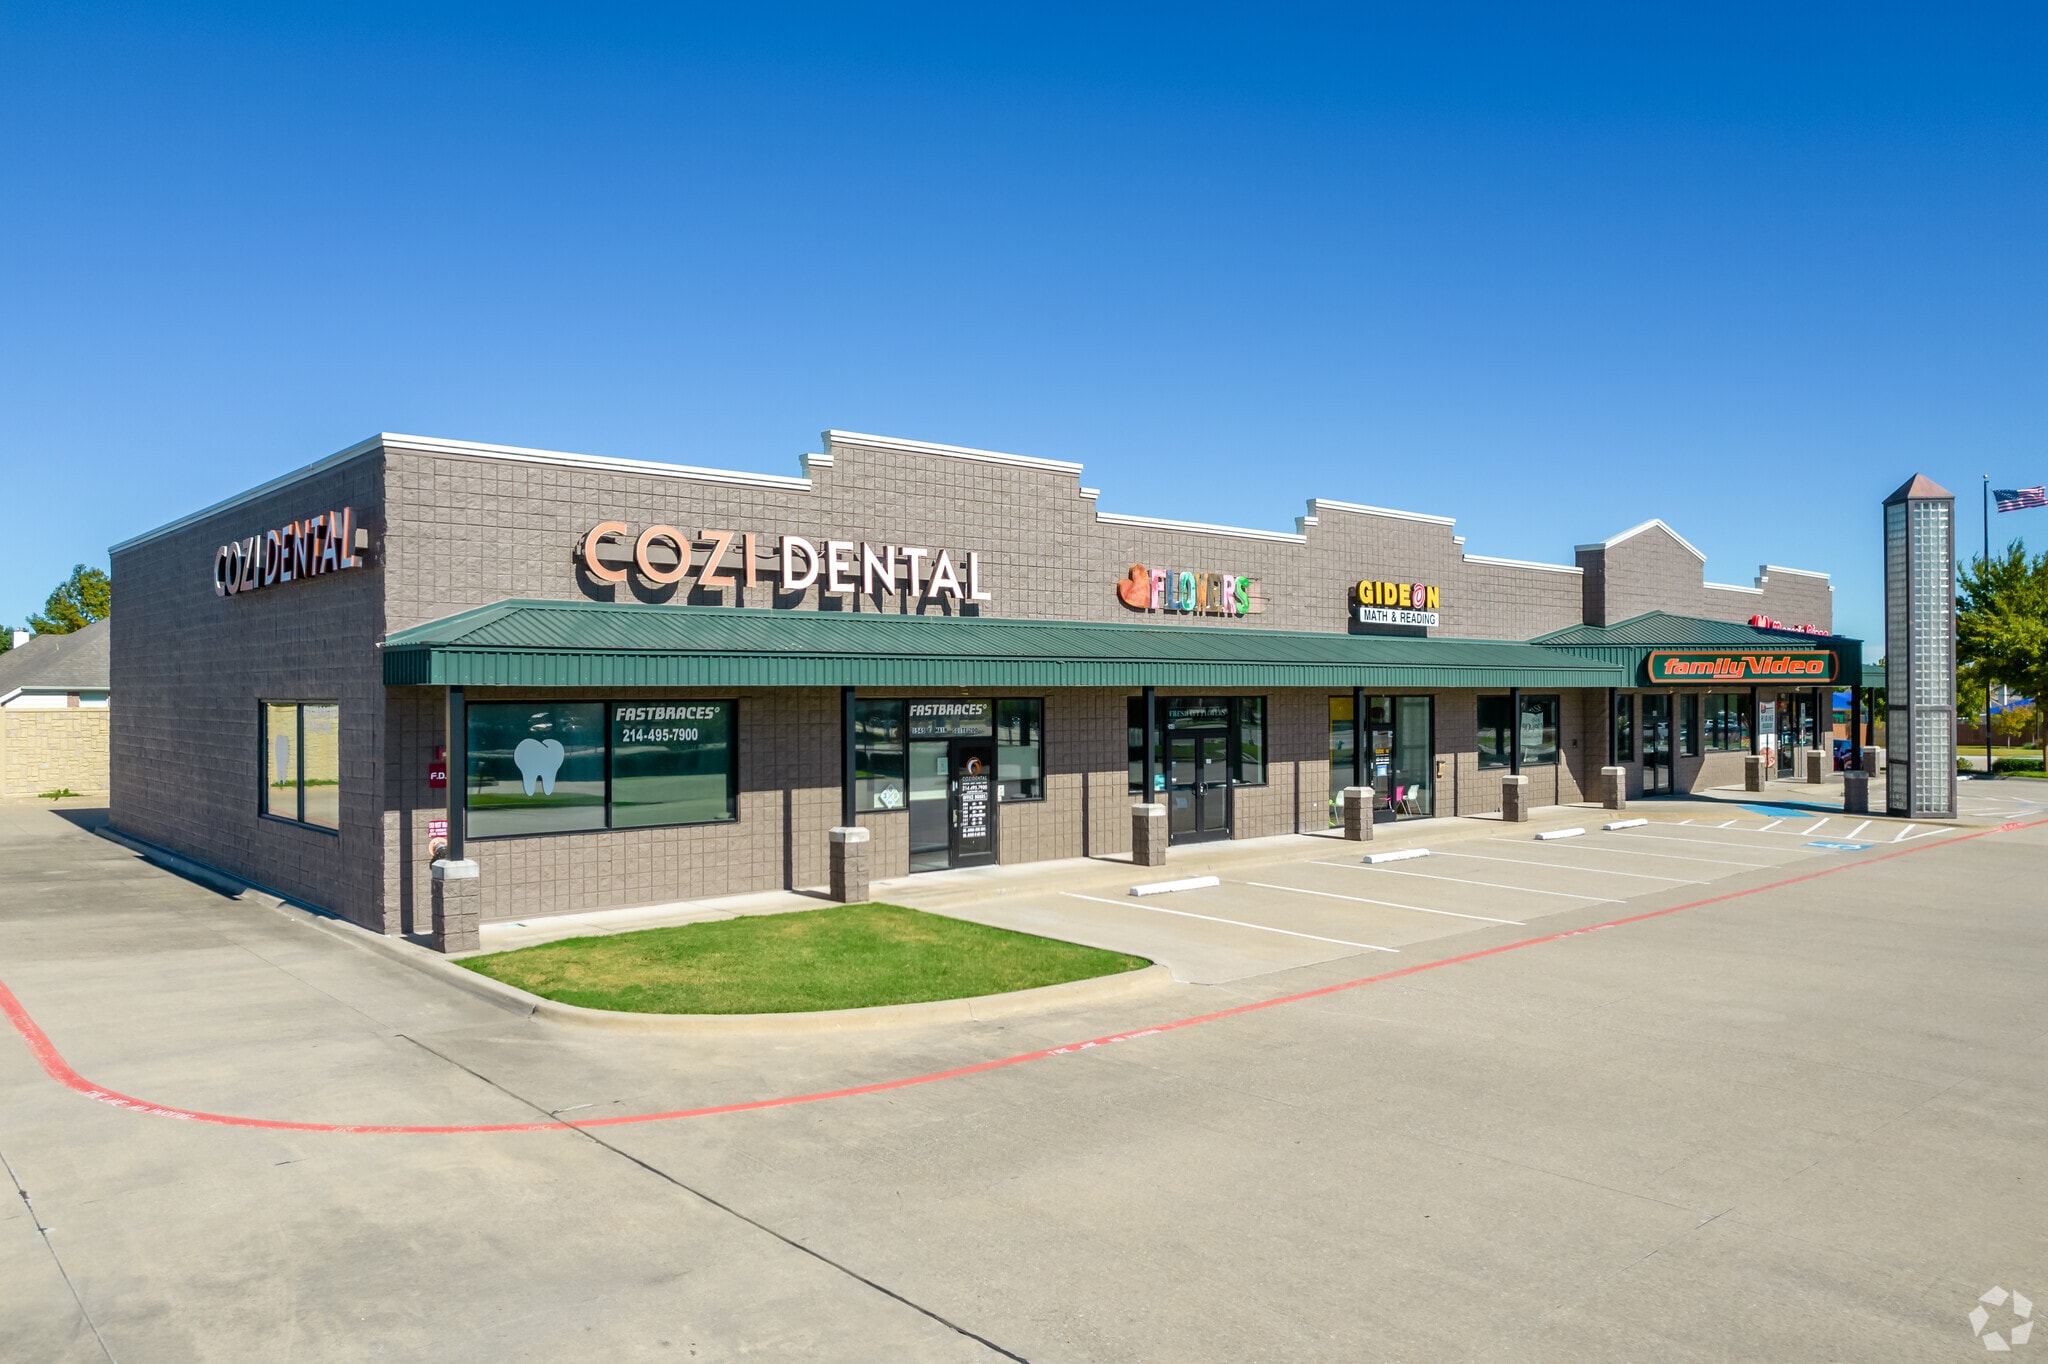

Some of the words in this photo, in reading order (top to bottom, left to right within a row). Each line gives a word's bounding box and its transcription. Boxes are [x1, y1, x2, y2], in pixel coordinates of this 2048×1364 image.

[213, 535, 263, 597] COZI
[265, 507, 358, 586] DENTAL
[584, 521, 757, 588] COZI
[780, 535, 992, 600] DENTAL
[1151, 568, 1250, 614] FLOWERS
[1359, 580, 1440, 609] GIDEON
[1364, 609, 1388, 622] MATH
[1391, 611, 1397, 622] &
[1400, 612, 1436, 625] READING
[1664, 657, 1746, 678] family
[1742, 656, 1825, 675] Video
[622, 728, 698, 742] 214-495-7900
